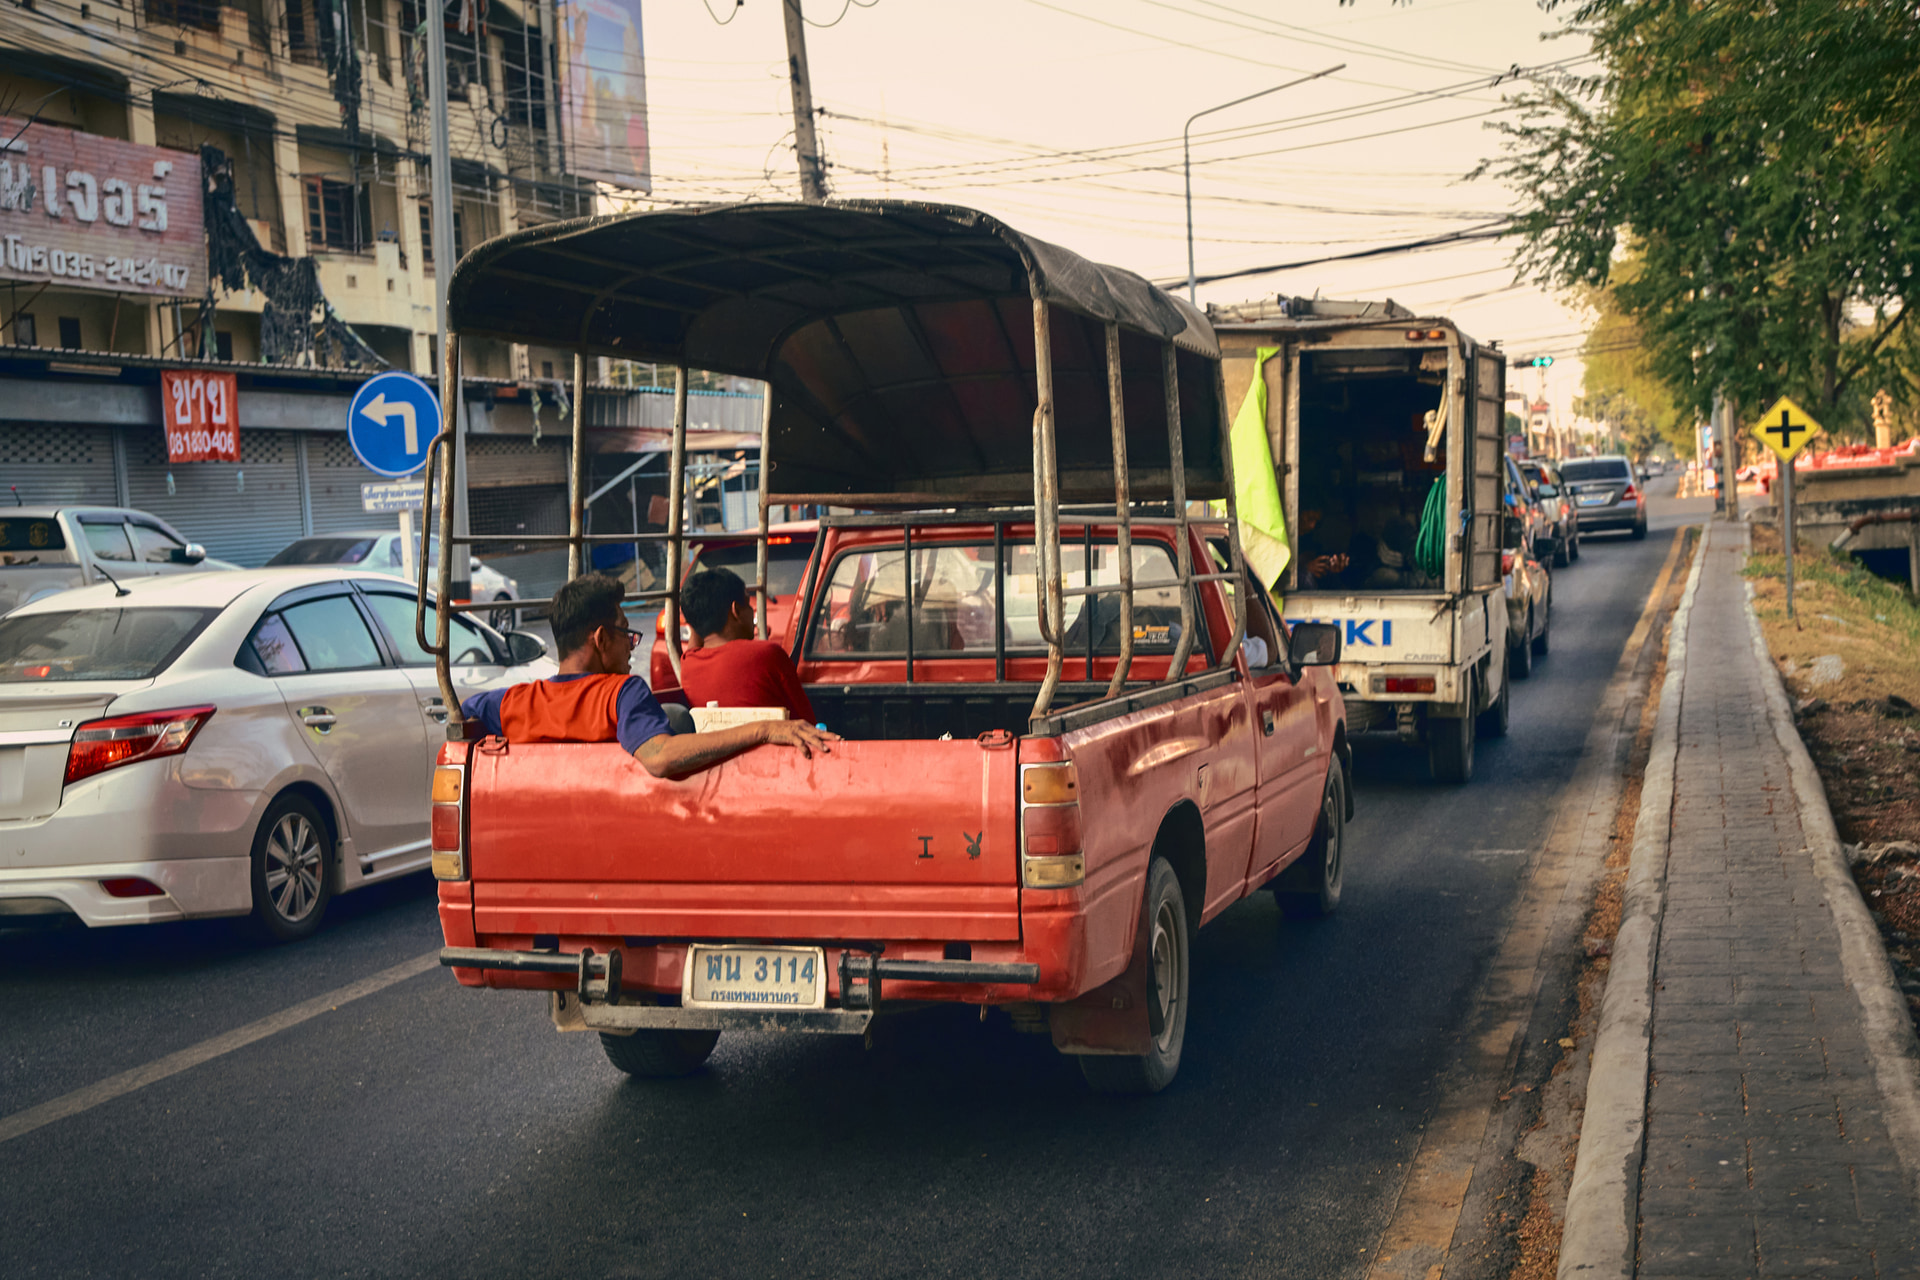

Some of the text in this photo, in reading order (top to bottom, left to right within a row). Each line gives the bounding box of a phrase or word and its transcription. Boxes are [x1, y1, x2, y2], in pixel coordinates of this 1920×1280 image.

[172, 379, 226, 424] ขาย
[754, 956, 815, 984] 3114
[711, 990, 799, 1004] กรงเทพมหานคร
